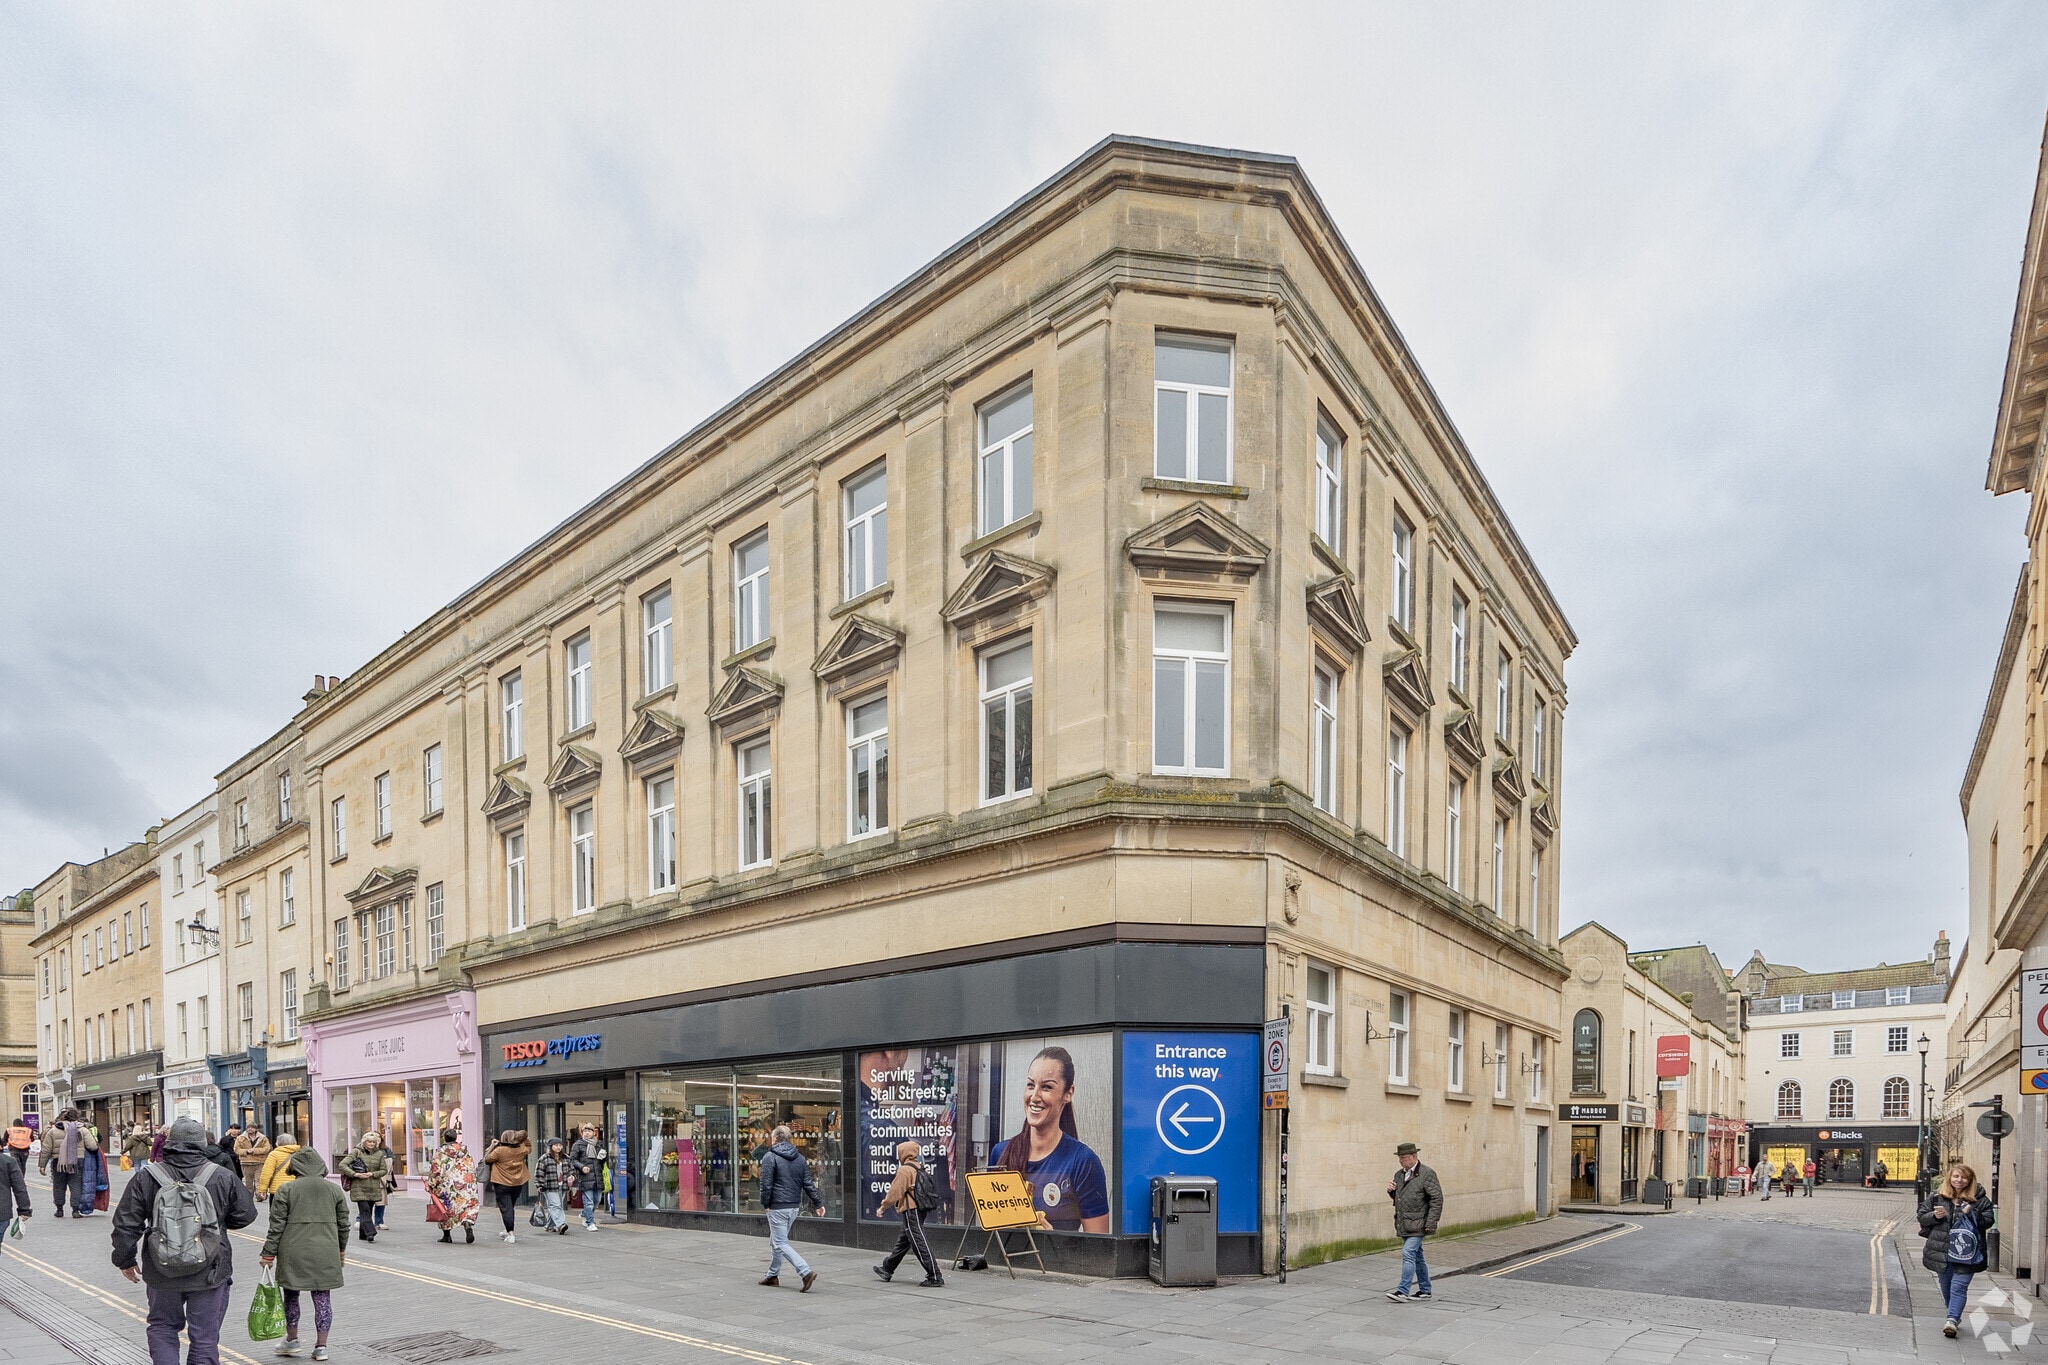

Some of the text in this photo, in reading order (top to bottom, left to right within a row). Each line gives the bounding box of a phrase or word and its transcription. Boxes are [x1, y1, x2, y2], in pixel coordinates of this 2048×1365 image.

[1265, 1022, 1287, 1030] PEDESTRIAN
[1268, 1029, 1284, 1039] ZONE
[364, 1042, 374, 1057] JOE
[378, 1039, 388, 1055] THE
[389, 1037, 404, 1053] JUICE
[502, 1033, 601, 1060] TESCO express
[1155, 1043, 1227, 1058] Entrance
[870, 1067, 915, 1084] Serving
[1155, 1064, 1222, 1082] this way.
[870, 1085, 946, 1101] Stall Street's
[870, 1105, 937, 1121] customers,
[870, 1122, 953, 1138] communities
[1831, 1131, 1863, 1139] Blacks
[870, 1142, 893, 1156] and
[938, 1146, 947, 1156] a
[870, 1160, 896, 1175] little
[991, 1182, 1008, 1193] No
[977, 1196, 1030, 1211] Reversing
